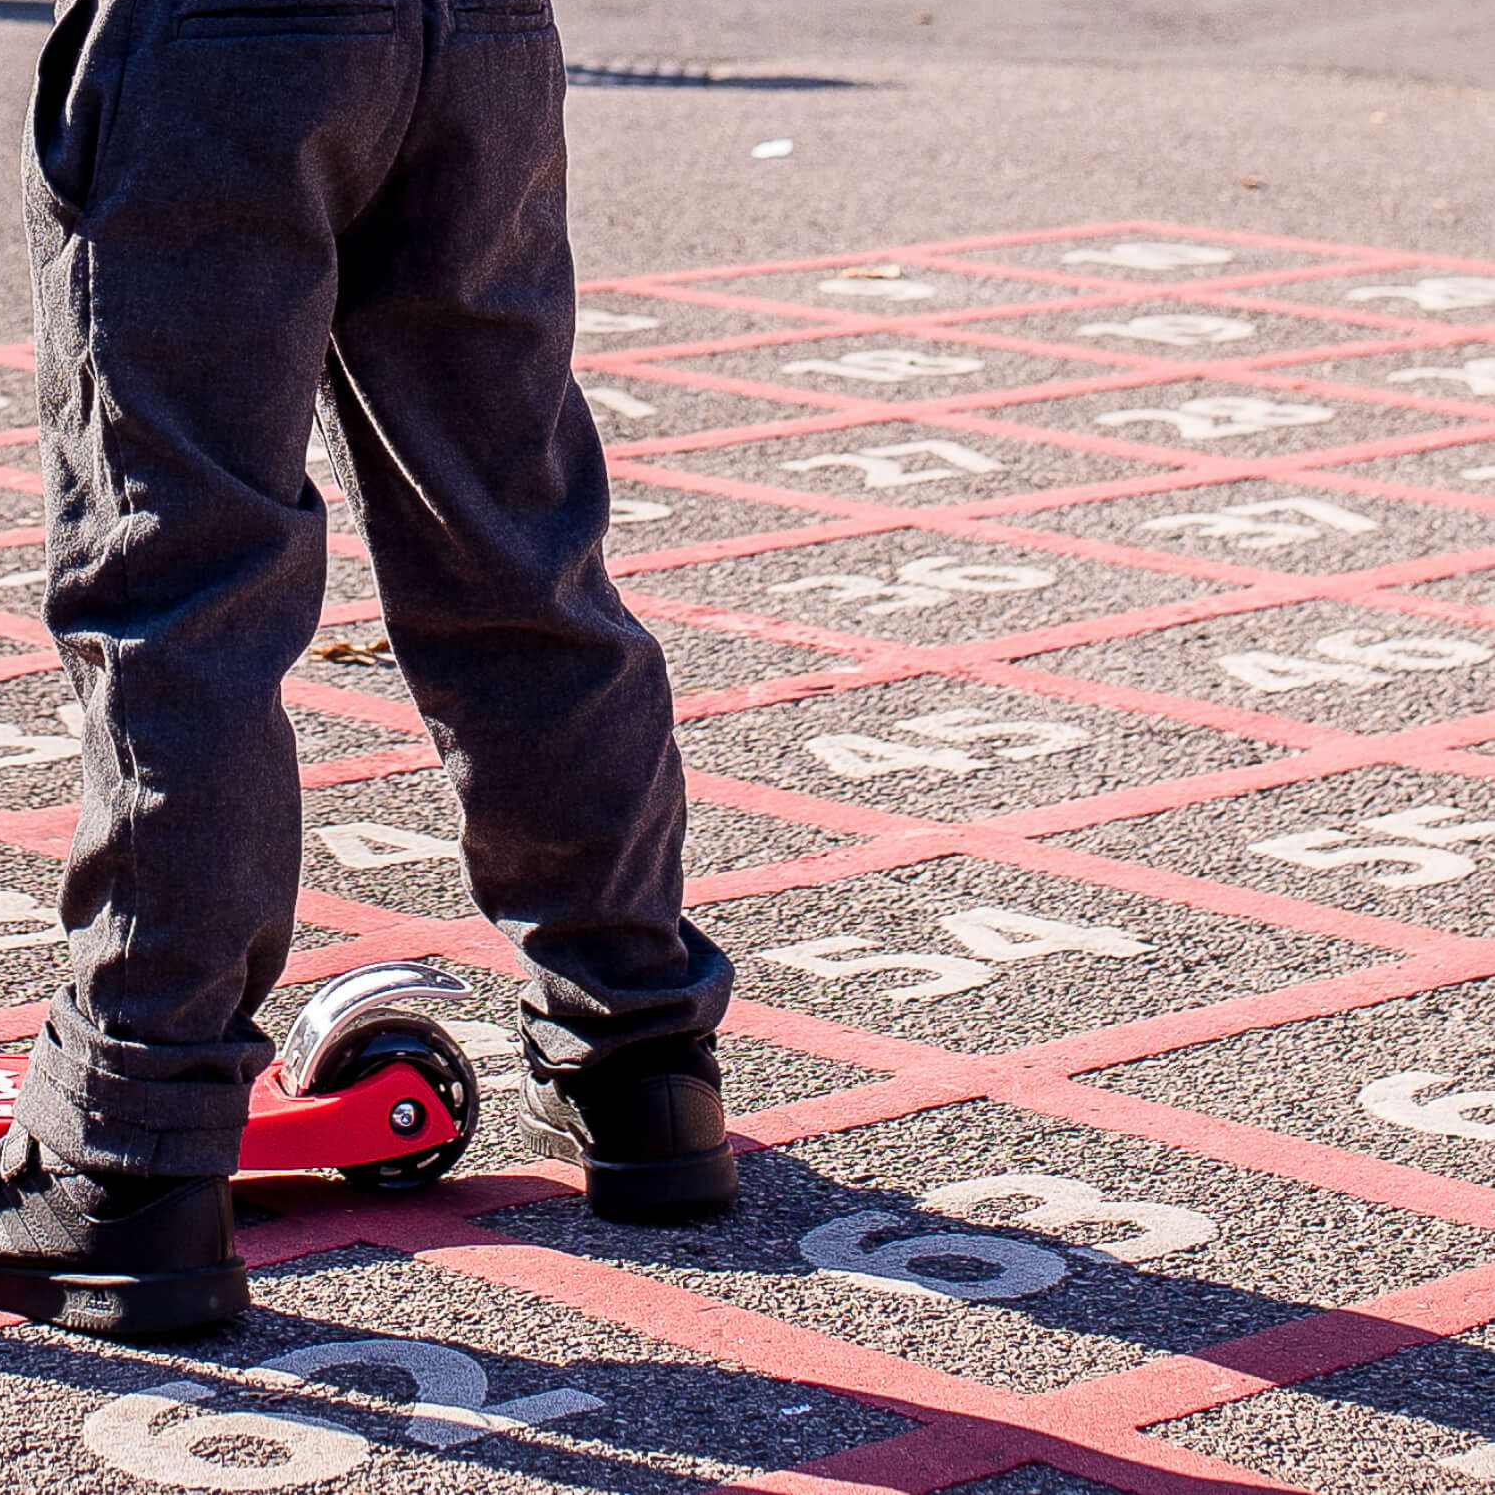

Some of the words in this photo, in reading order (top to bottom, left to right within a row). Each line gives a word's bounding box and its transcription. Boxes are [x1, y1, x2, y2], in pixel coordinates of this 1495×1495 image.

[1095, 397, 1336, 440] 28
[778, 439, 1005, 488] 27
[1139, 498, 1377, 548] 37
[768, 556, 1056, 616] 36
[1217, 629, 1495, 693] 46
[804, 708, 1093, 779] 45
[760, 908, 1160, 1001] 54
[801, 1174, 1219, 1301] 63
[83, 1339, 606, 1491] 62
